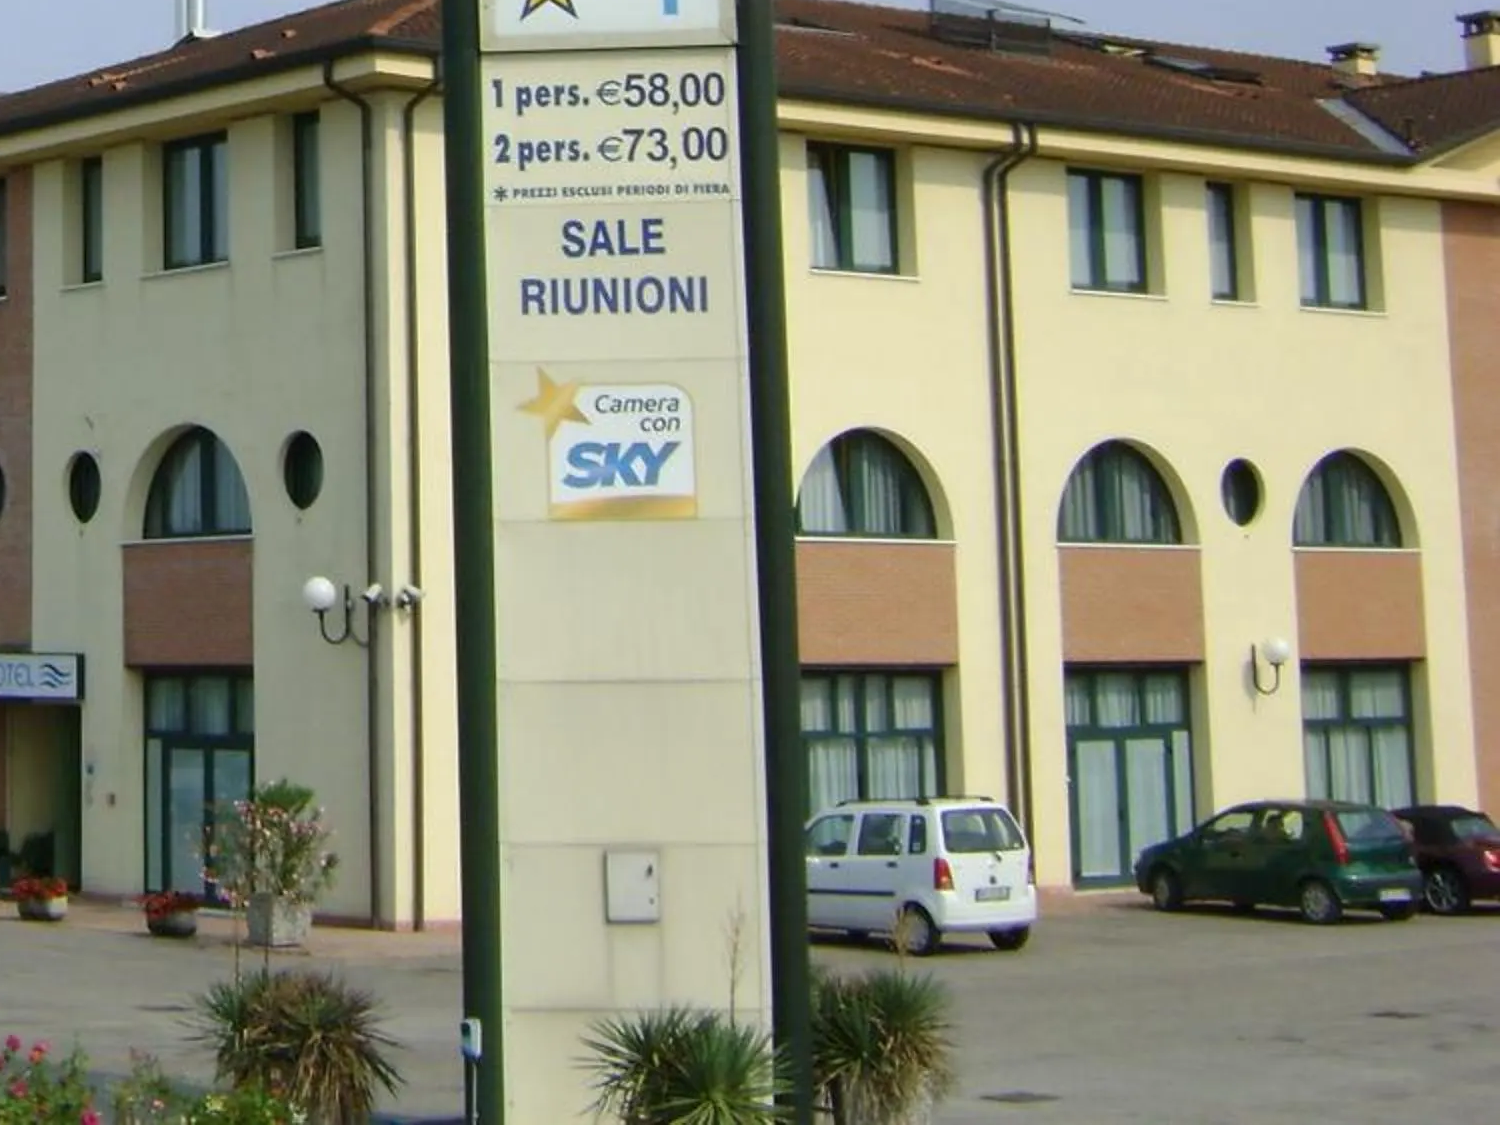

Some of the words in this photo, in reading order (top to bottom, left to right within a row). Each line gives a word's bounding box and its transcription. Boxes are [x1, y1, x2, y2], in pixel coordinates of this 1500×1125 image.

[491, 78, 504, 108] 1
[515, 83, 590, 116] pers.
[595, 71, 726, 115] €58,00
[493, 133, 511, 164] 2
[517, 136, 591, 171] pers.
[596, 126, 729, 170] €73,00
[512, 186, 558, 199] PREZZI
[561, 185, 613, 198] ESCLUSI
[616, 184, 670, 197] PERIODI
[674, 183, 689, 195] DI
[693, 182, 730, 195] FIERA
[561, 218, 666, 258] SALE
[519, 276, 709, 316] RIUNIONI
[594, 394, 680, 414] Camera
[639, 416, 681, 432] con
[561, 440, 682, 489] SKY
